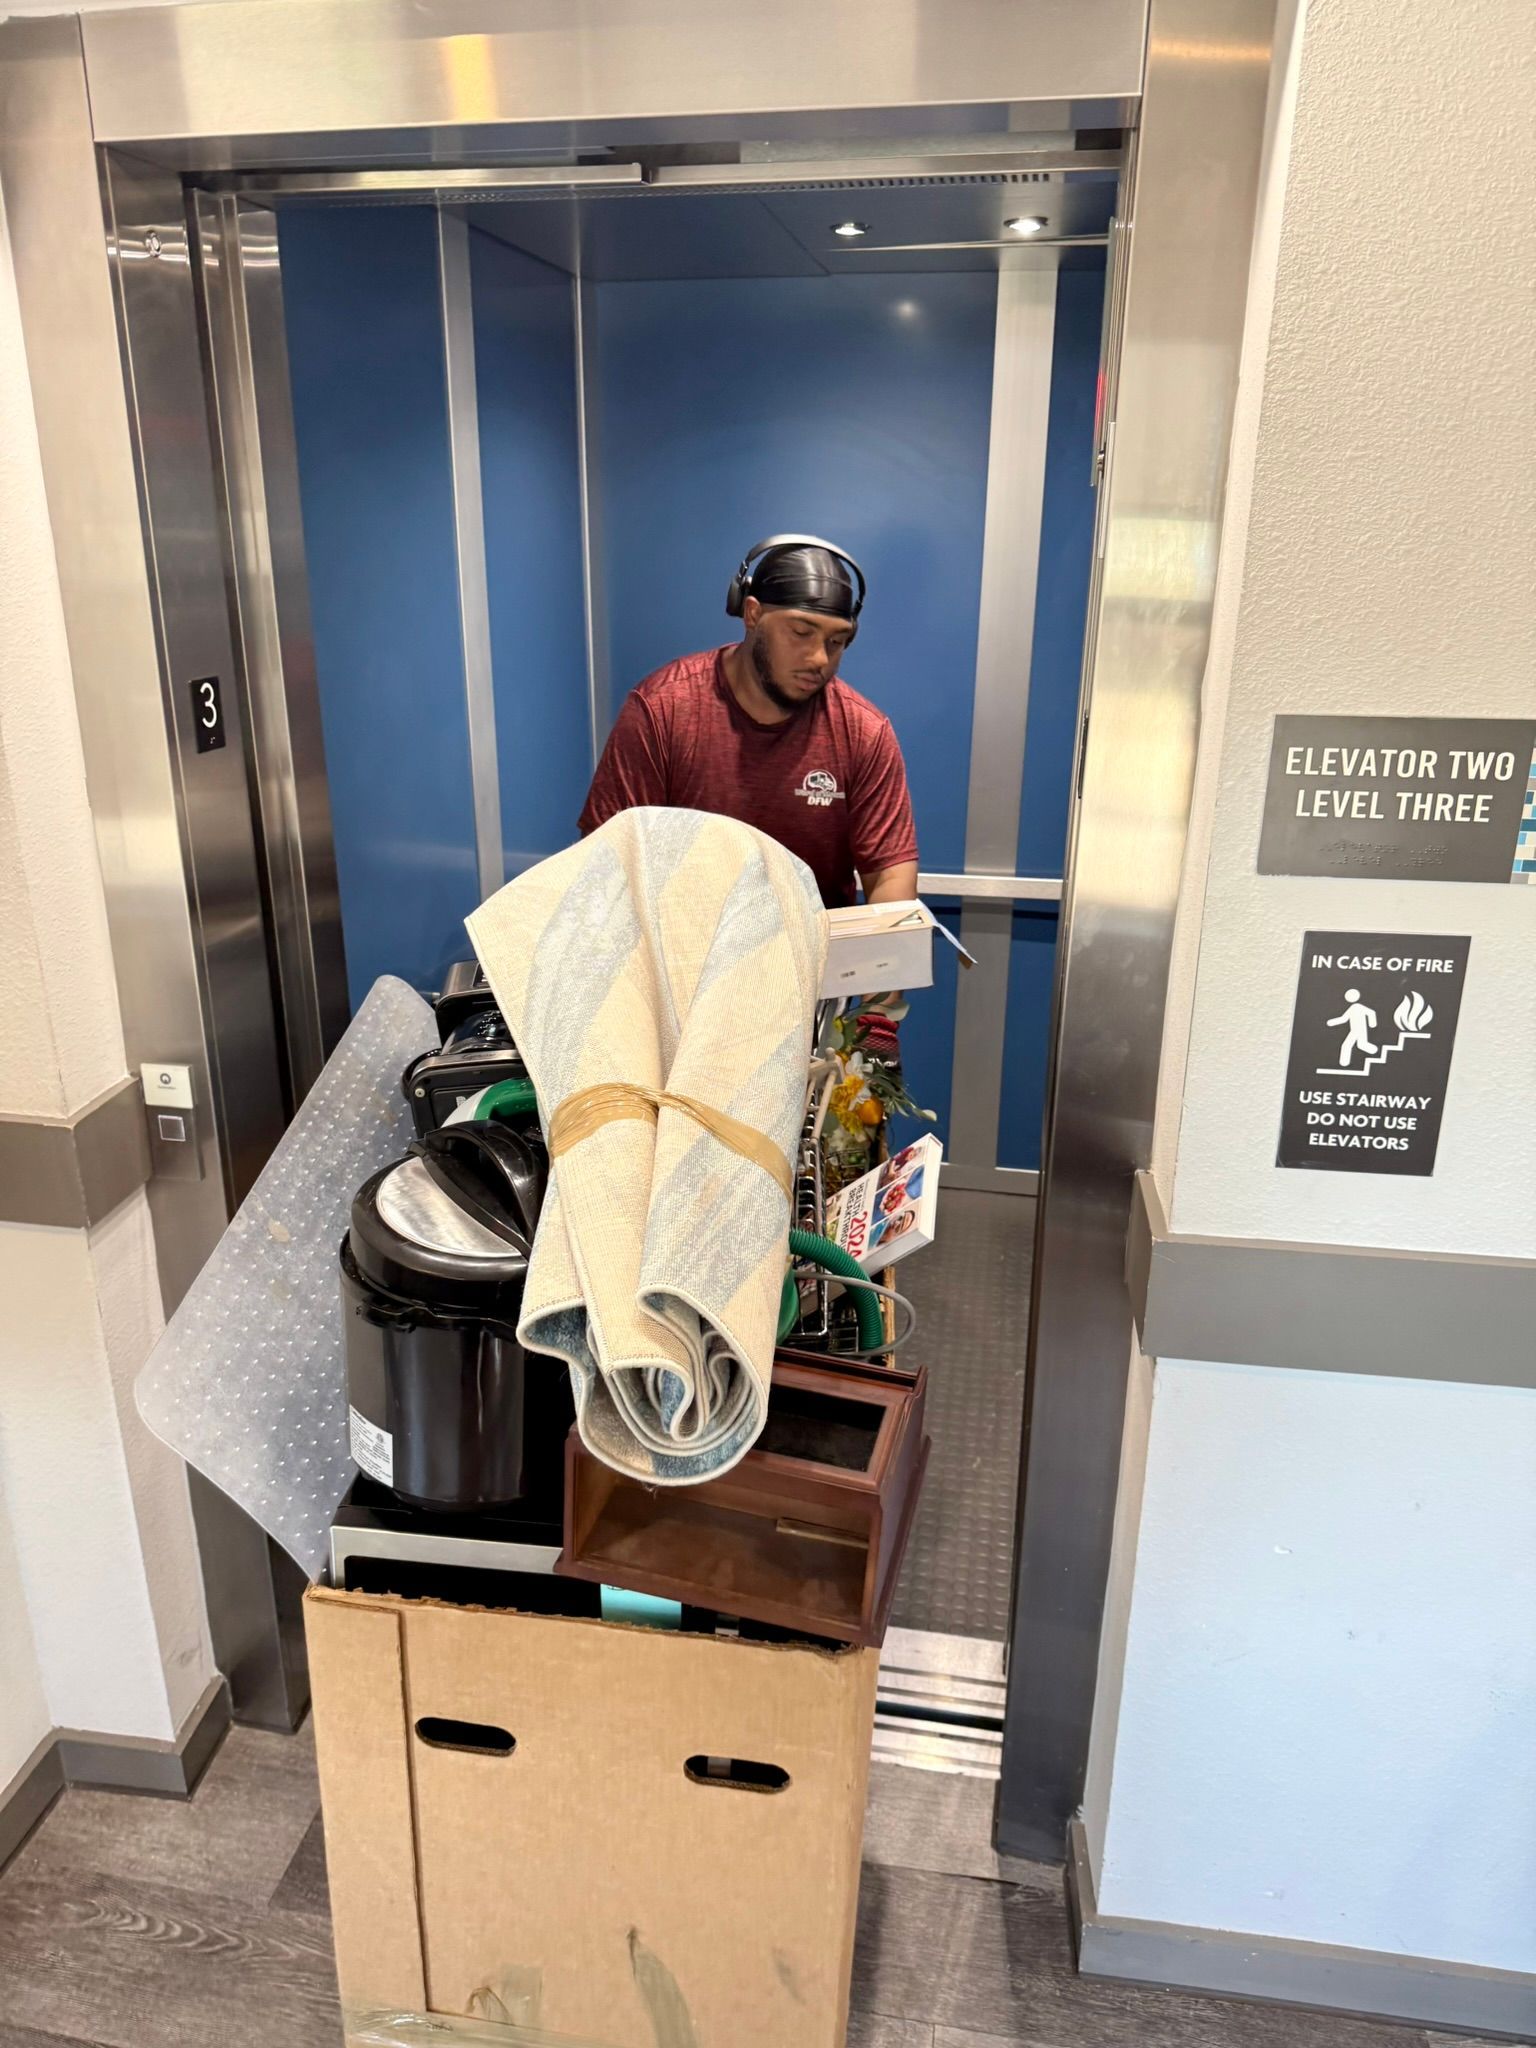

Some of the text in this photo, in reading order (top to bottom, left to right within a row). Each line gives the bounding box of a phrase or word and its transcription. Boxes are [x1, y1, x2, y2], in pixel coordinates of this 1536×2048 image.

[200, 682, 217, 728] 3
[1285, 747, 1515, 781] ELEVATOR TWO
[1295, 789, 1494, 823] LEVEL THREE
[1311, 954, 1454, 973] IN CASE OF FIRE
[1299, 1090, 1432, 1110] USE STAIRWAY
[1306, 1112, 1418, 1131] DO NOT USE
[1308, 1132, 1409, 1151] ELEVATORS
[851, 1182, 865, 1218] HEALTH
